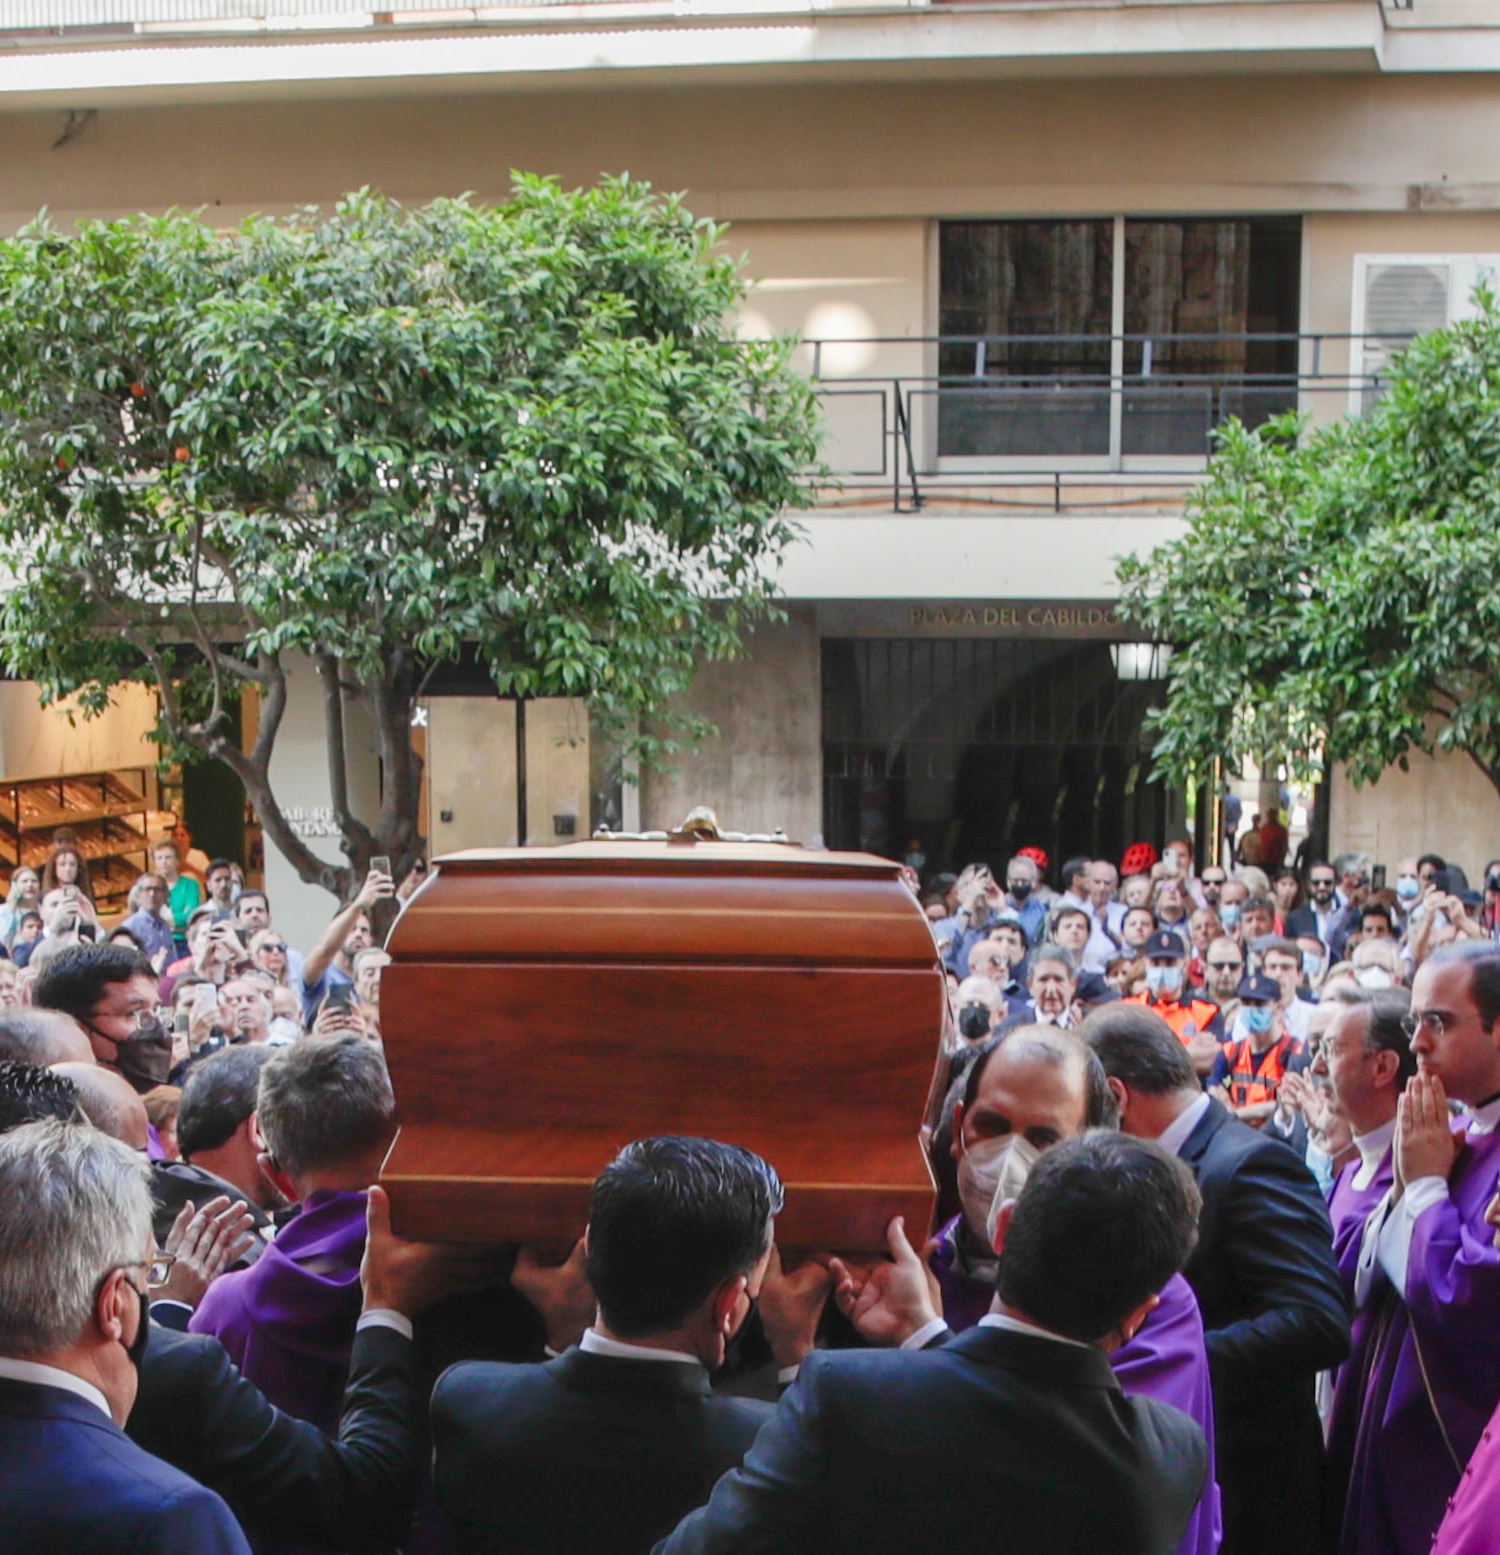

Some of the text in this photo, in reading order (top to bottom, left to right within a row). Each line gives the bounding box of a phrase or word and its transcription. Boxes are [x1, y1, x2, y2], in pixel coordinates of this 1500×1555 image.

[911, 607, 1120, 624] PLAZA DEL CABILDO
